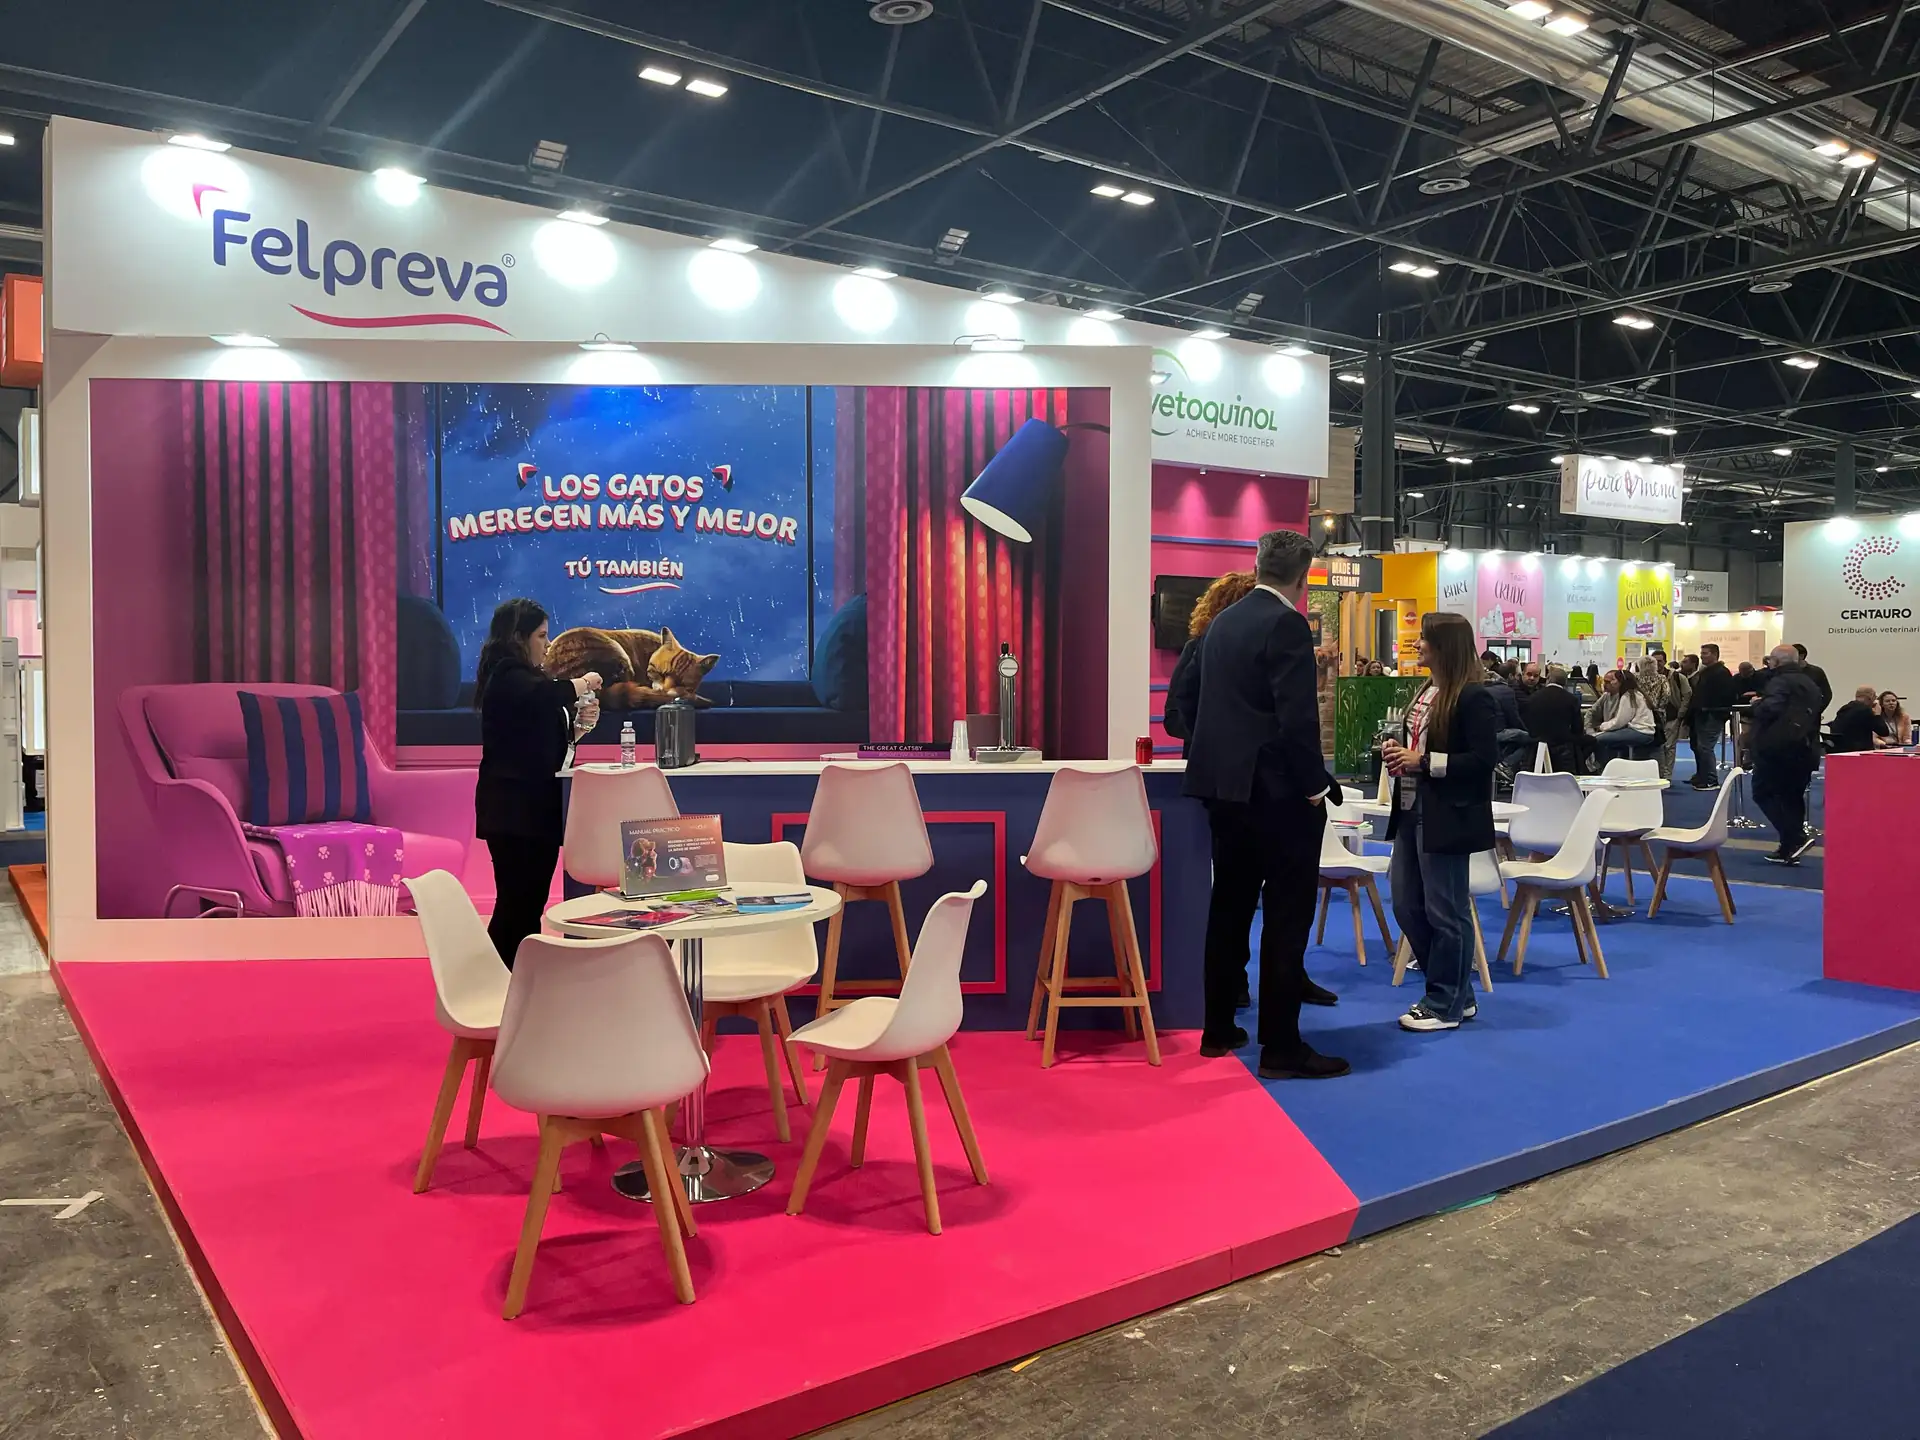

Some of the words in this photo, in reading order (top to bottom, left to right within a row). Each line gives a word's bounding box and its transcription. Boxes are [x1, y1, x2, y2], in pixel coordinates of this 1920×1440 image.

[1186, 428, 1216, 441] ACHIEVE
[1218, 433, 1238, 444] MORE
[1240, 435, 1275, 448] TOGETHER
[543, 474, 600, 500] LOS
[607, 474, 704, 501] GATOS
[450, 504, 592, 541] MERECEN
[598, 498, 665, 530] MÁS
[671, 505, 690, 529] Y
[697, 507, 799, 543] MEJOR
[565, 557, 592, 578] TÚ
[596, 558, 684, 579] TAMBIÉN
[1331, 561, 1351, 575] MADE
[1352, 562, 1360, 575] IN
[1331, 575, 1360, 588] GERMANY
[1841, 608, 1912, 620] CENTAURO
[1828, 625, 1878, 635] Distribución
[1880, 624, 1920, 634] veterinari
[629, 828, 652, 836] MANUAL
